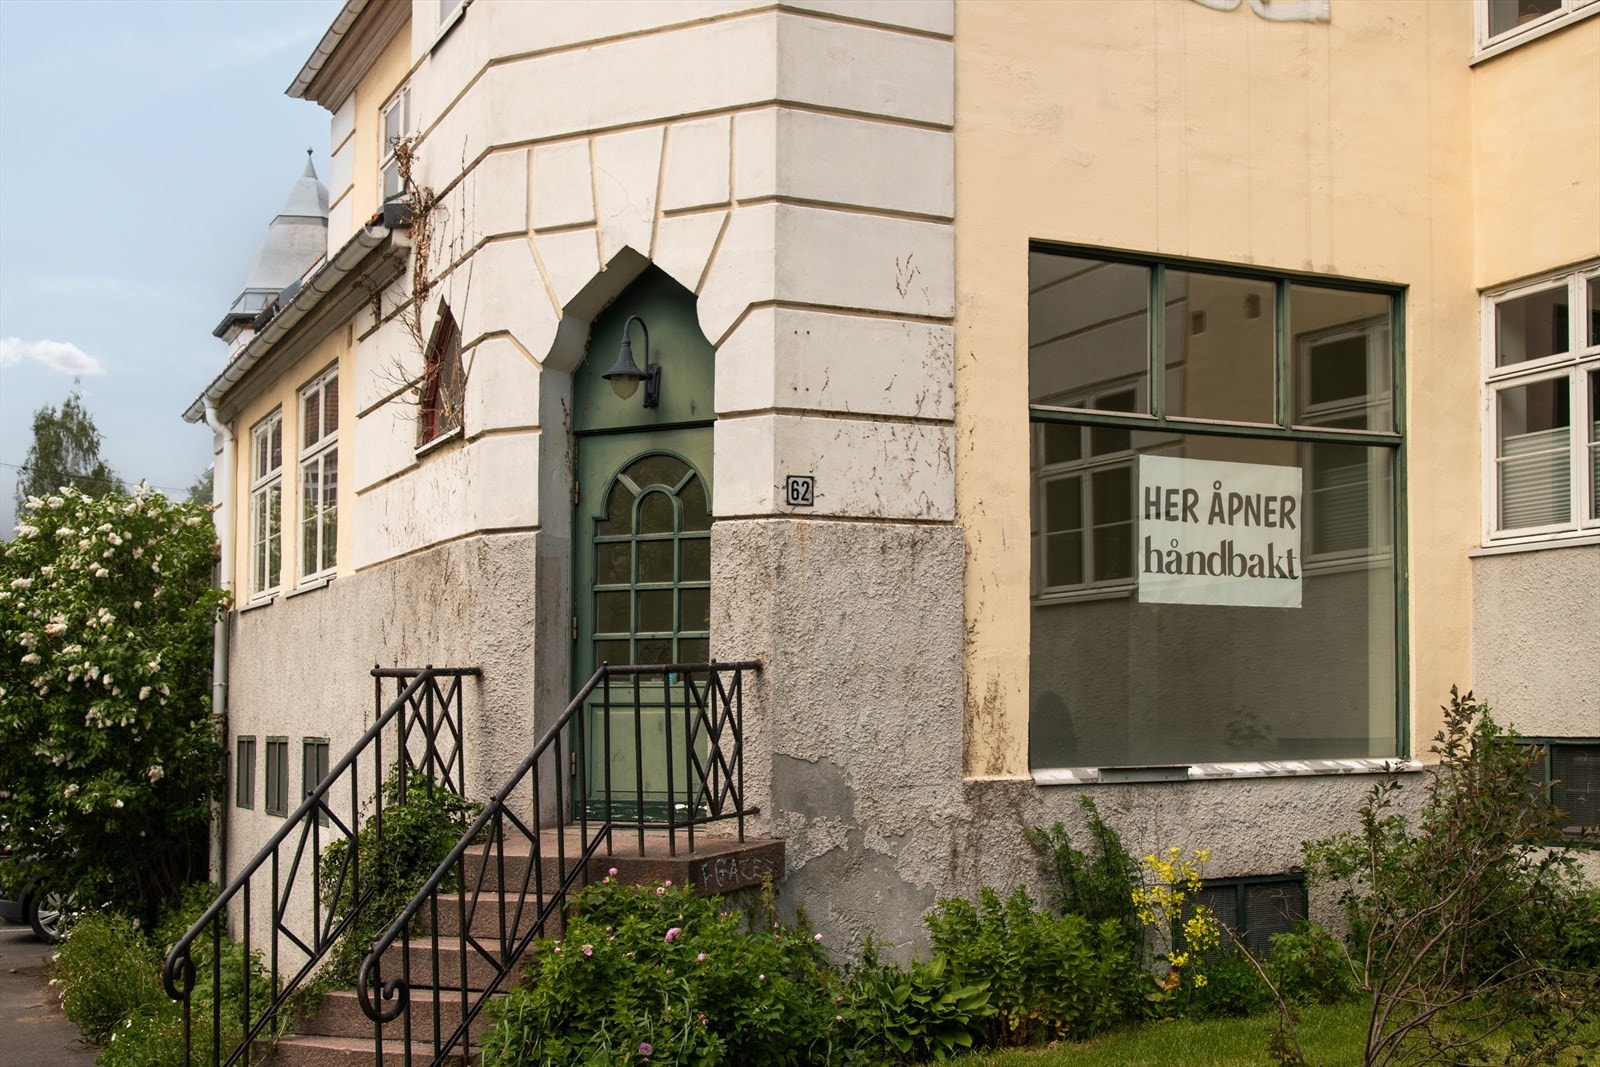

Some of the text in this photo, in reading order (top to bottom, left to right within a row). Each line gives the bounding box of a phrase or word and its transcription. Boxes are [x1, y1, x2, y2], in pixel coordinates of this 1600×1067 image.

[791, 480, 810, 501] 62
[1144, 480, 1297, 530] HER ÅPNER
[1143, 534, 1300, 580] håndbakt
